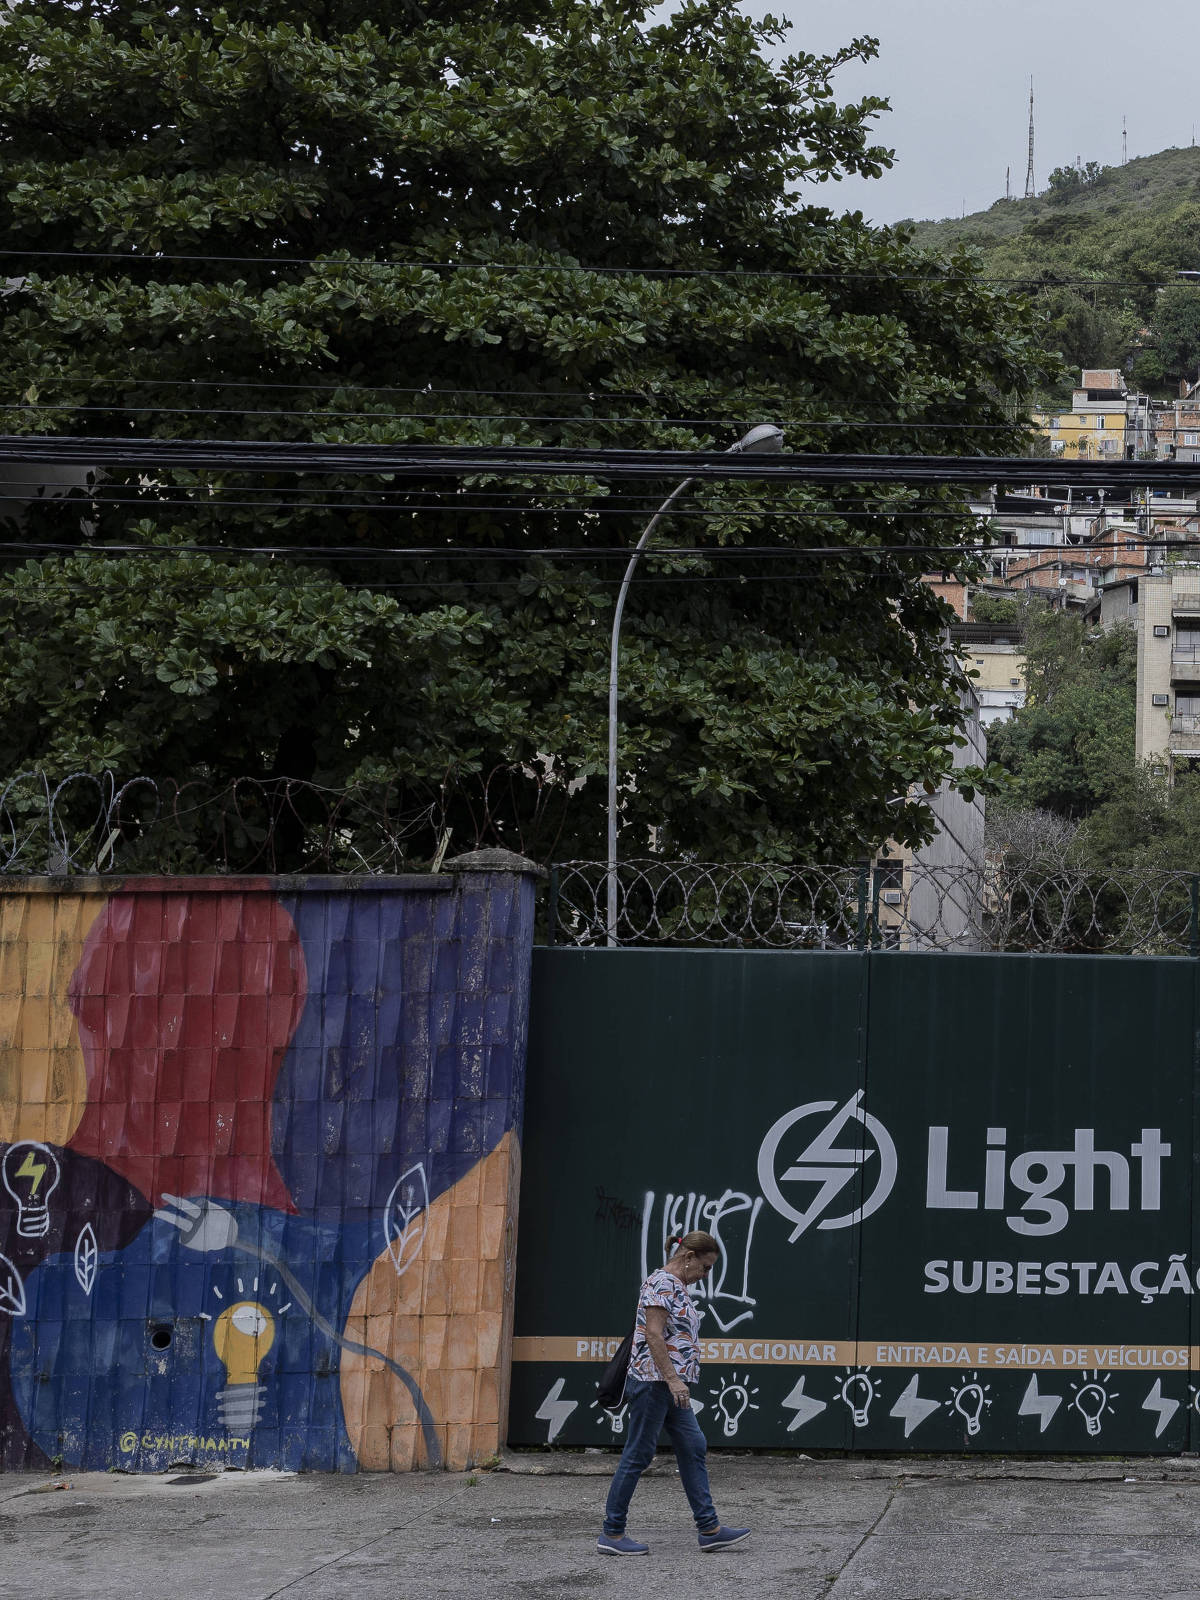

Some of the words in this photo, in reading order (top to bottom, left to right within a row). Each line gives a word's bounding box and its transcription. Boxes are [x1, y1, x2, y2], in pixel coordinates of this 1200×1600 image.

[925, 1126, 1172, 1236] Light
[876, 1345, 971, 1364] ENTRADA
[977, 1347, 988, 1364] E
[994, 1345, 1056, 1365] SAÍDA
[1062, 1348, 1088, 1365] DE
[1094, 1345, 1190, 1367] VEÍCULOS
